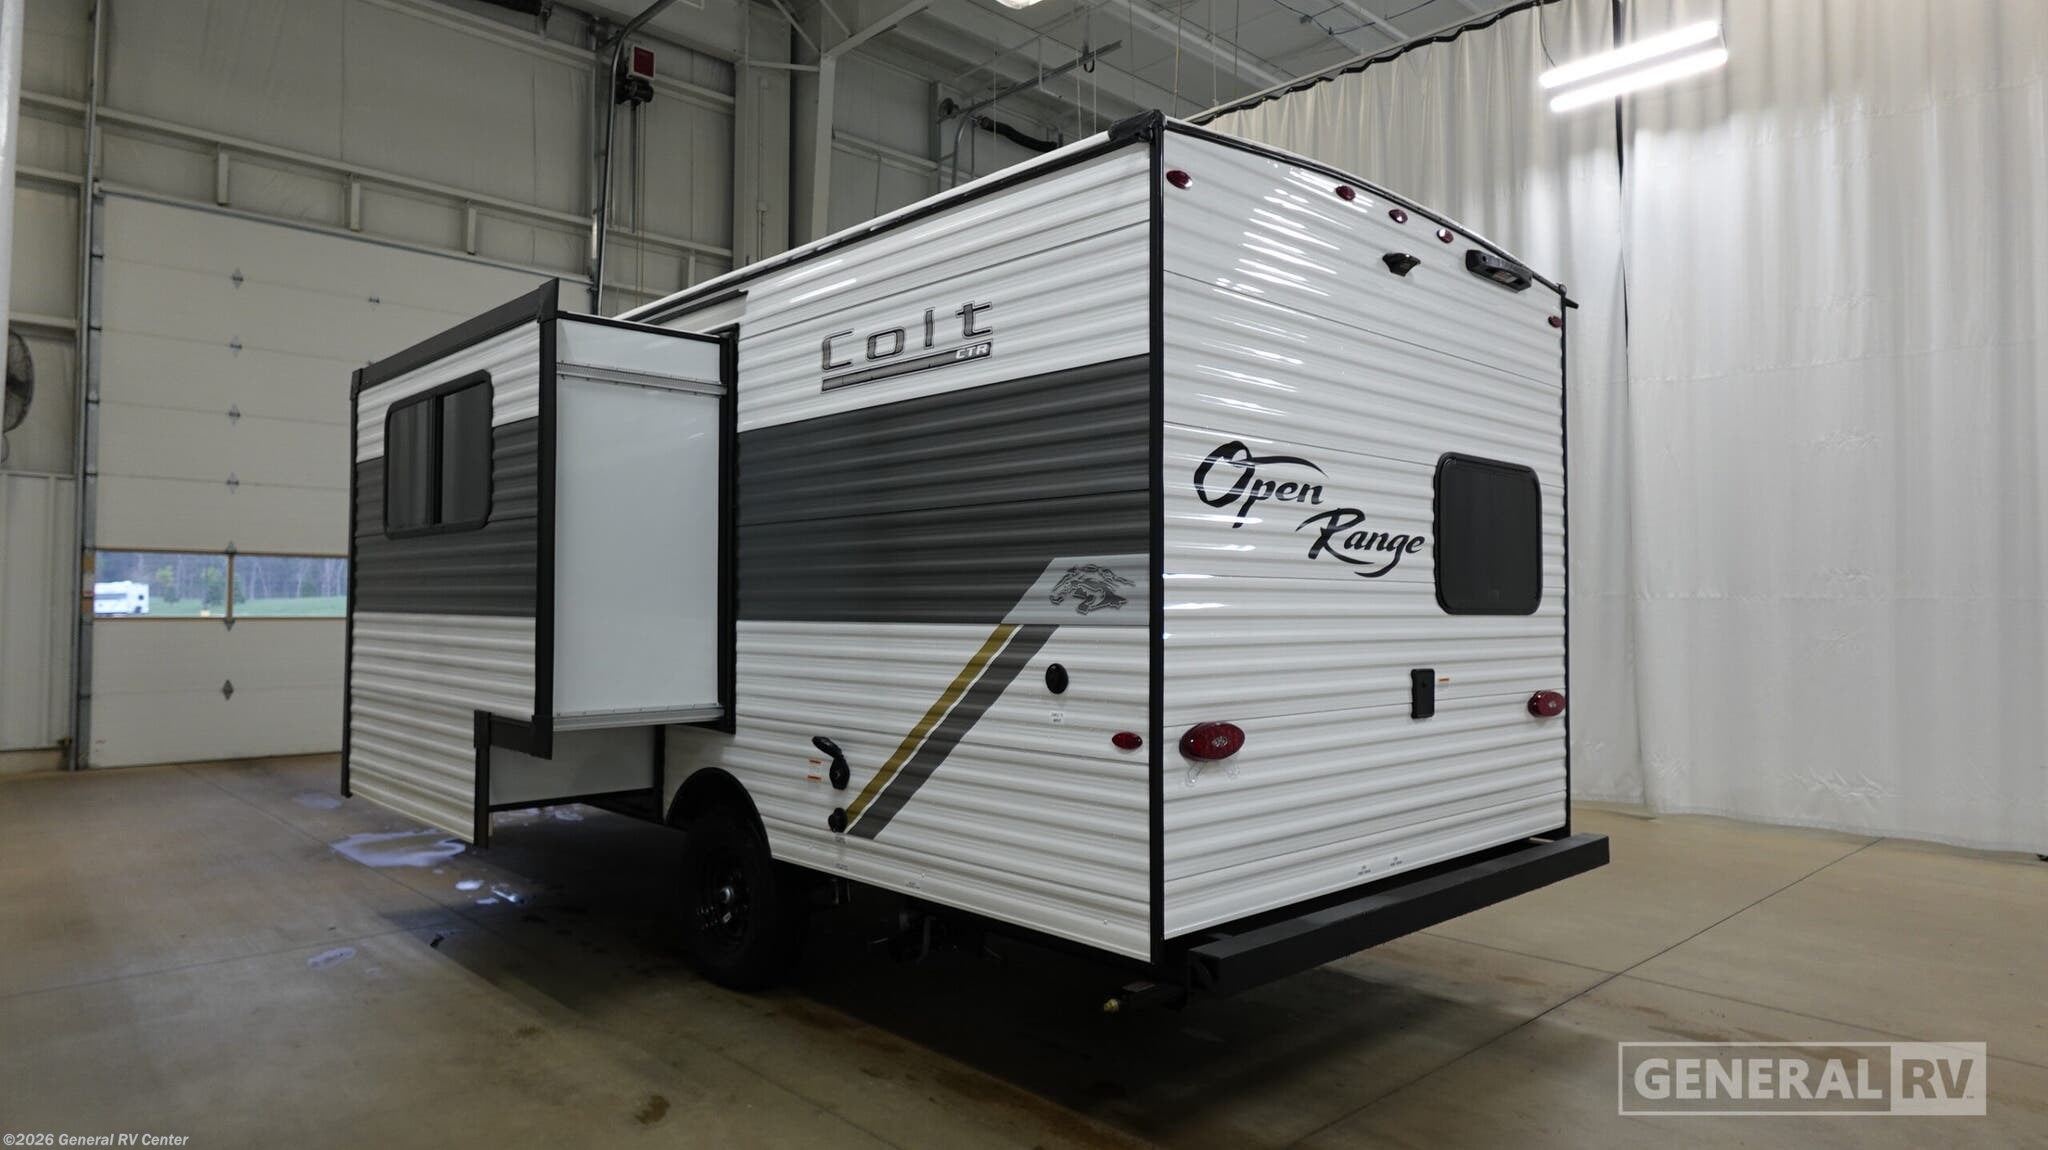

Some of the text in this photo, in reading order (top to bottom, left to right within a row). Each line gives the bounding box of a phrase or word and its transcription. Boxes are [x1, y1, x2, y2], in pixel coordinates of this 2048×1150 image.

[821, 301, 993, 371] Colt
[955, 342, 989, 360] CTR
[1193, 440, 1329, 529] Open
[1295, 508, 1426, 578] Range
